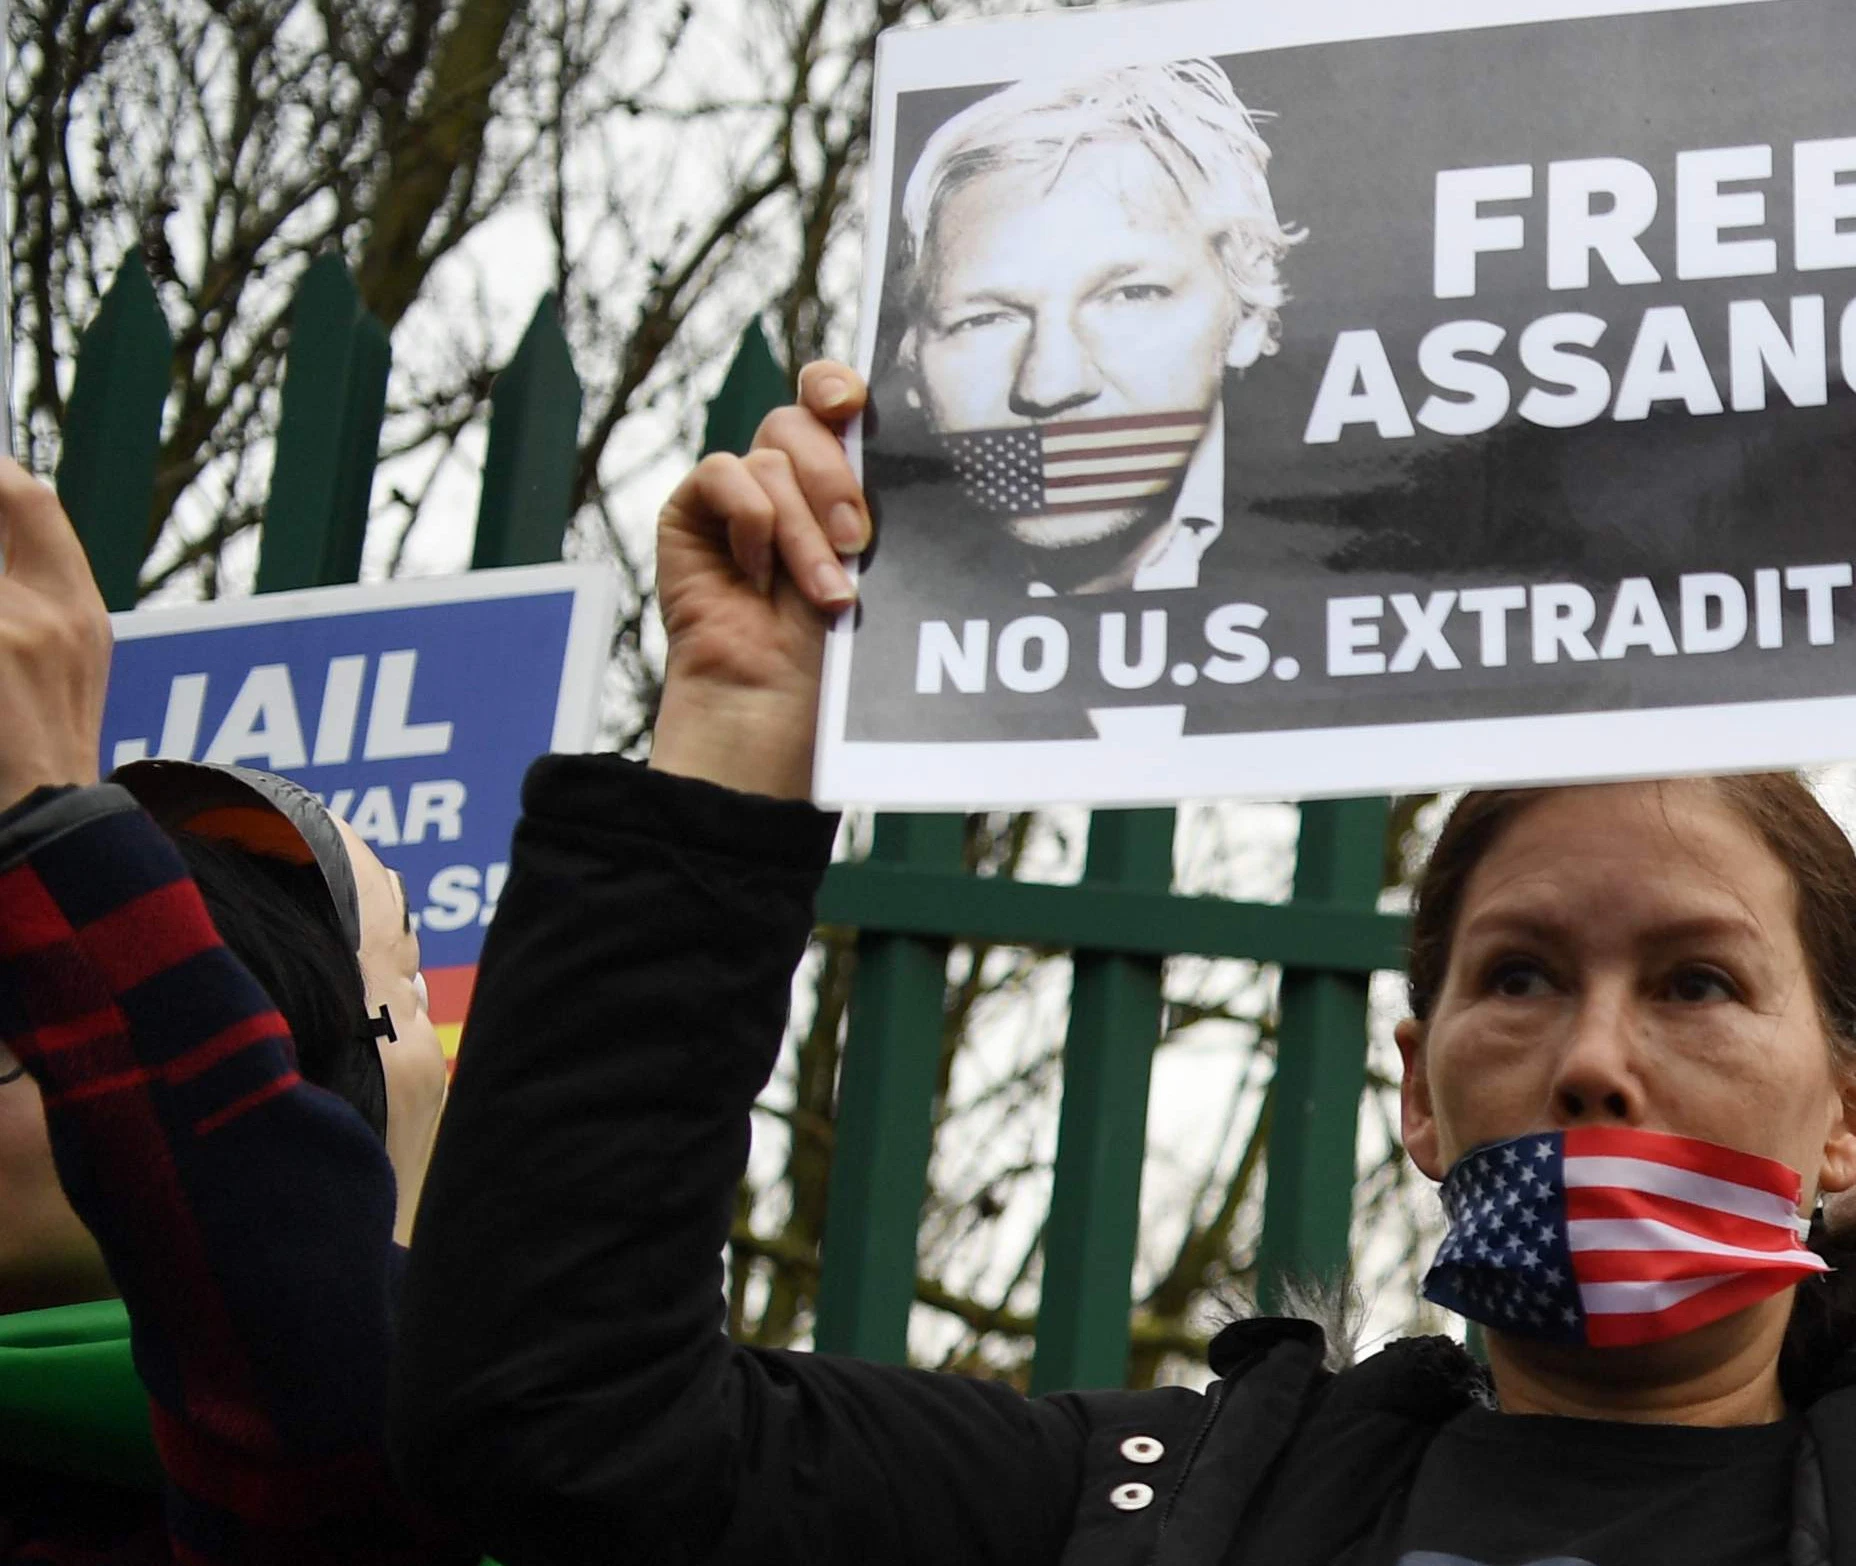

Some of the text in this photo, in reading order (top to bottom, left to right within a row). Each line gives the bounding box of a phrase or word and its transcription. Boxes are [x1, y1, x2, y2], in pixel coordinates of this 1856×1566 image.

[915, 615, 1069, 695] NO
[1098, 603, 1300, 689] U.S.
[113, 649, 453, 769] JAIL
